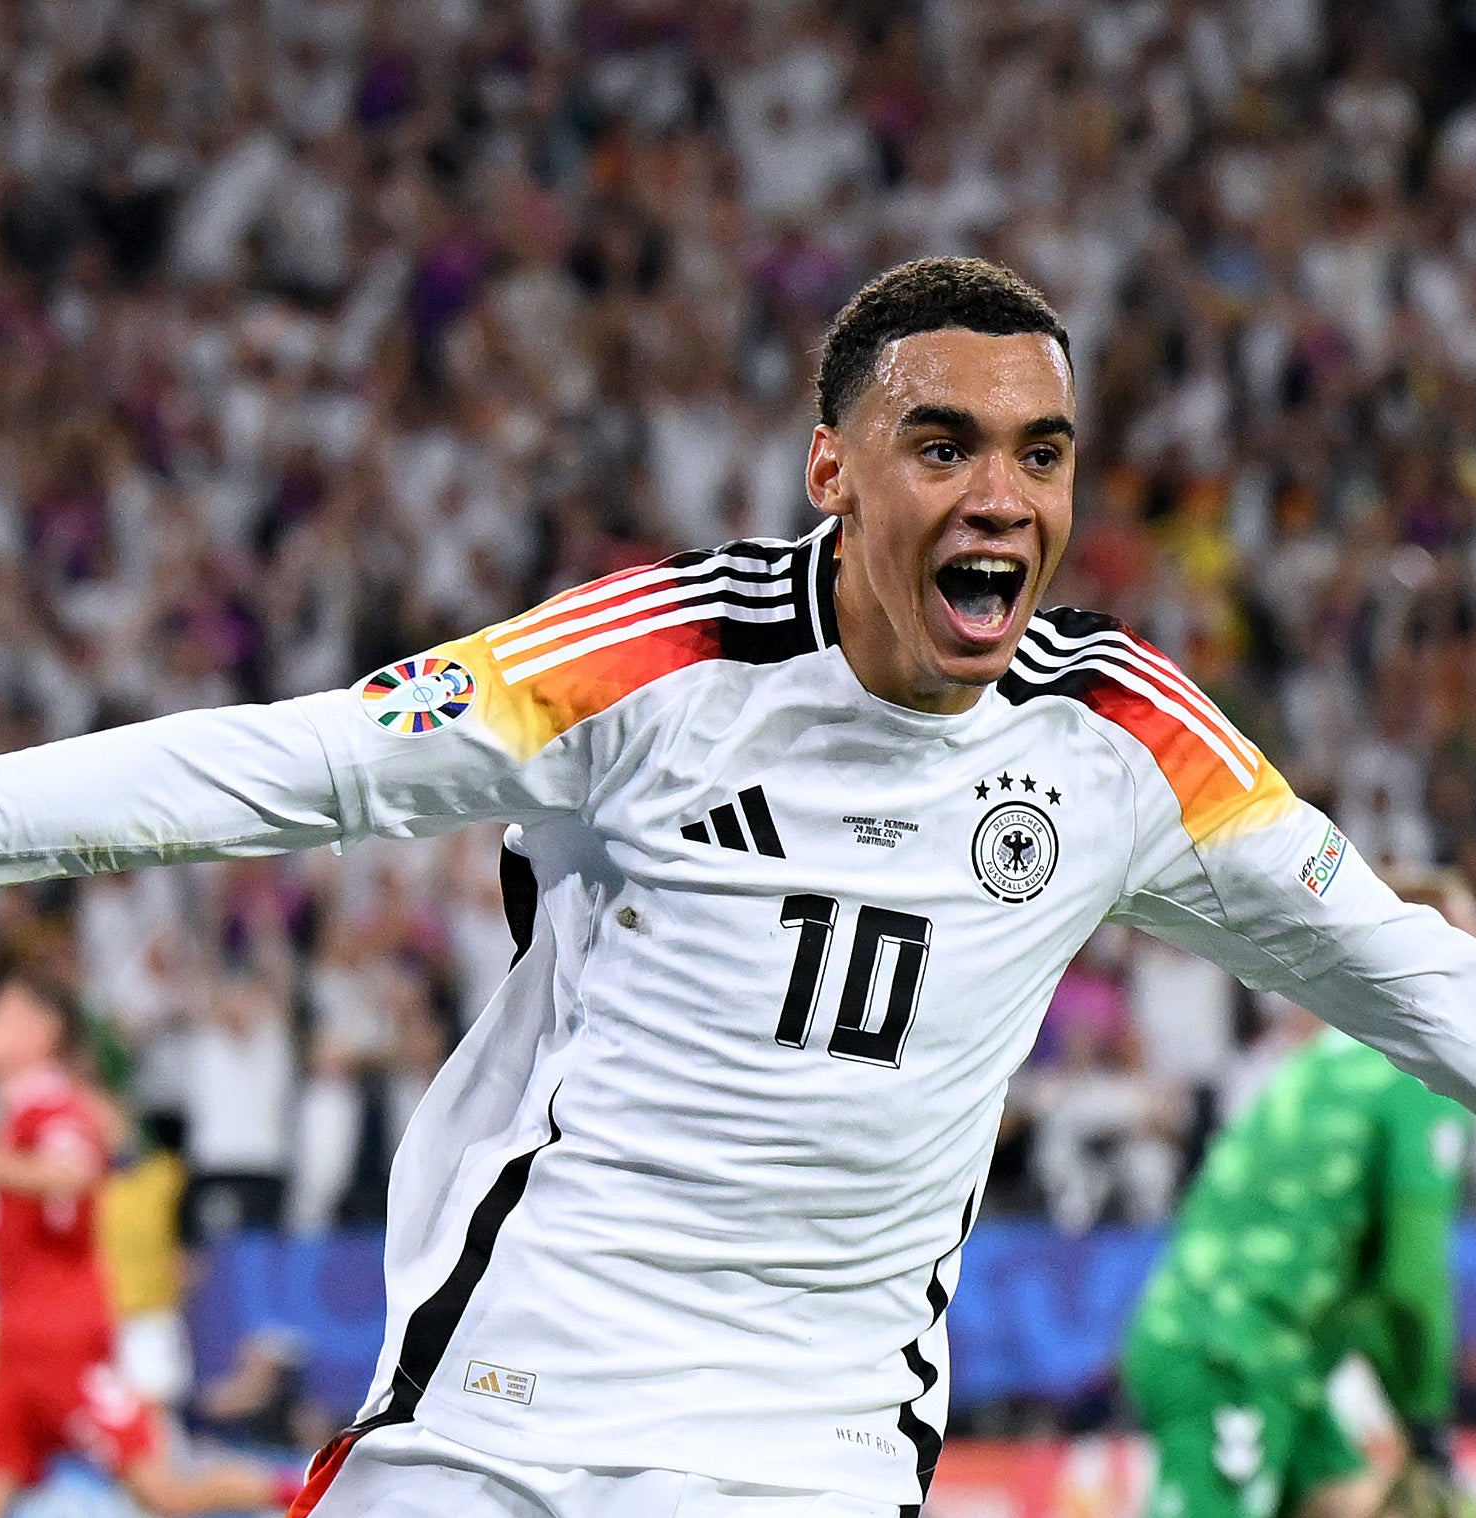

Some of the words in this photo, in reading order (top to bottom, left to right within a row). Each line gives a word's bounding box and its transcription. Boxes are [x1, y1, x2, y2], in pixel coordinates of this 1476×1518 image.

[865, 826, 882, 836] JUNE
[884, 828, 902, 840] 2024
[993, 814, 1043, 834] DEUTSCHER
[856, 835, 896, 848] DORTMUND
[986, 861, 1045, 890] FUSSBALL-BUND
[1298, 855, 1318, 882] UEFA
[774, 893, 933, 1070] 10
